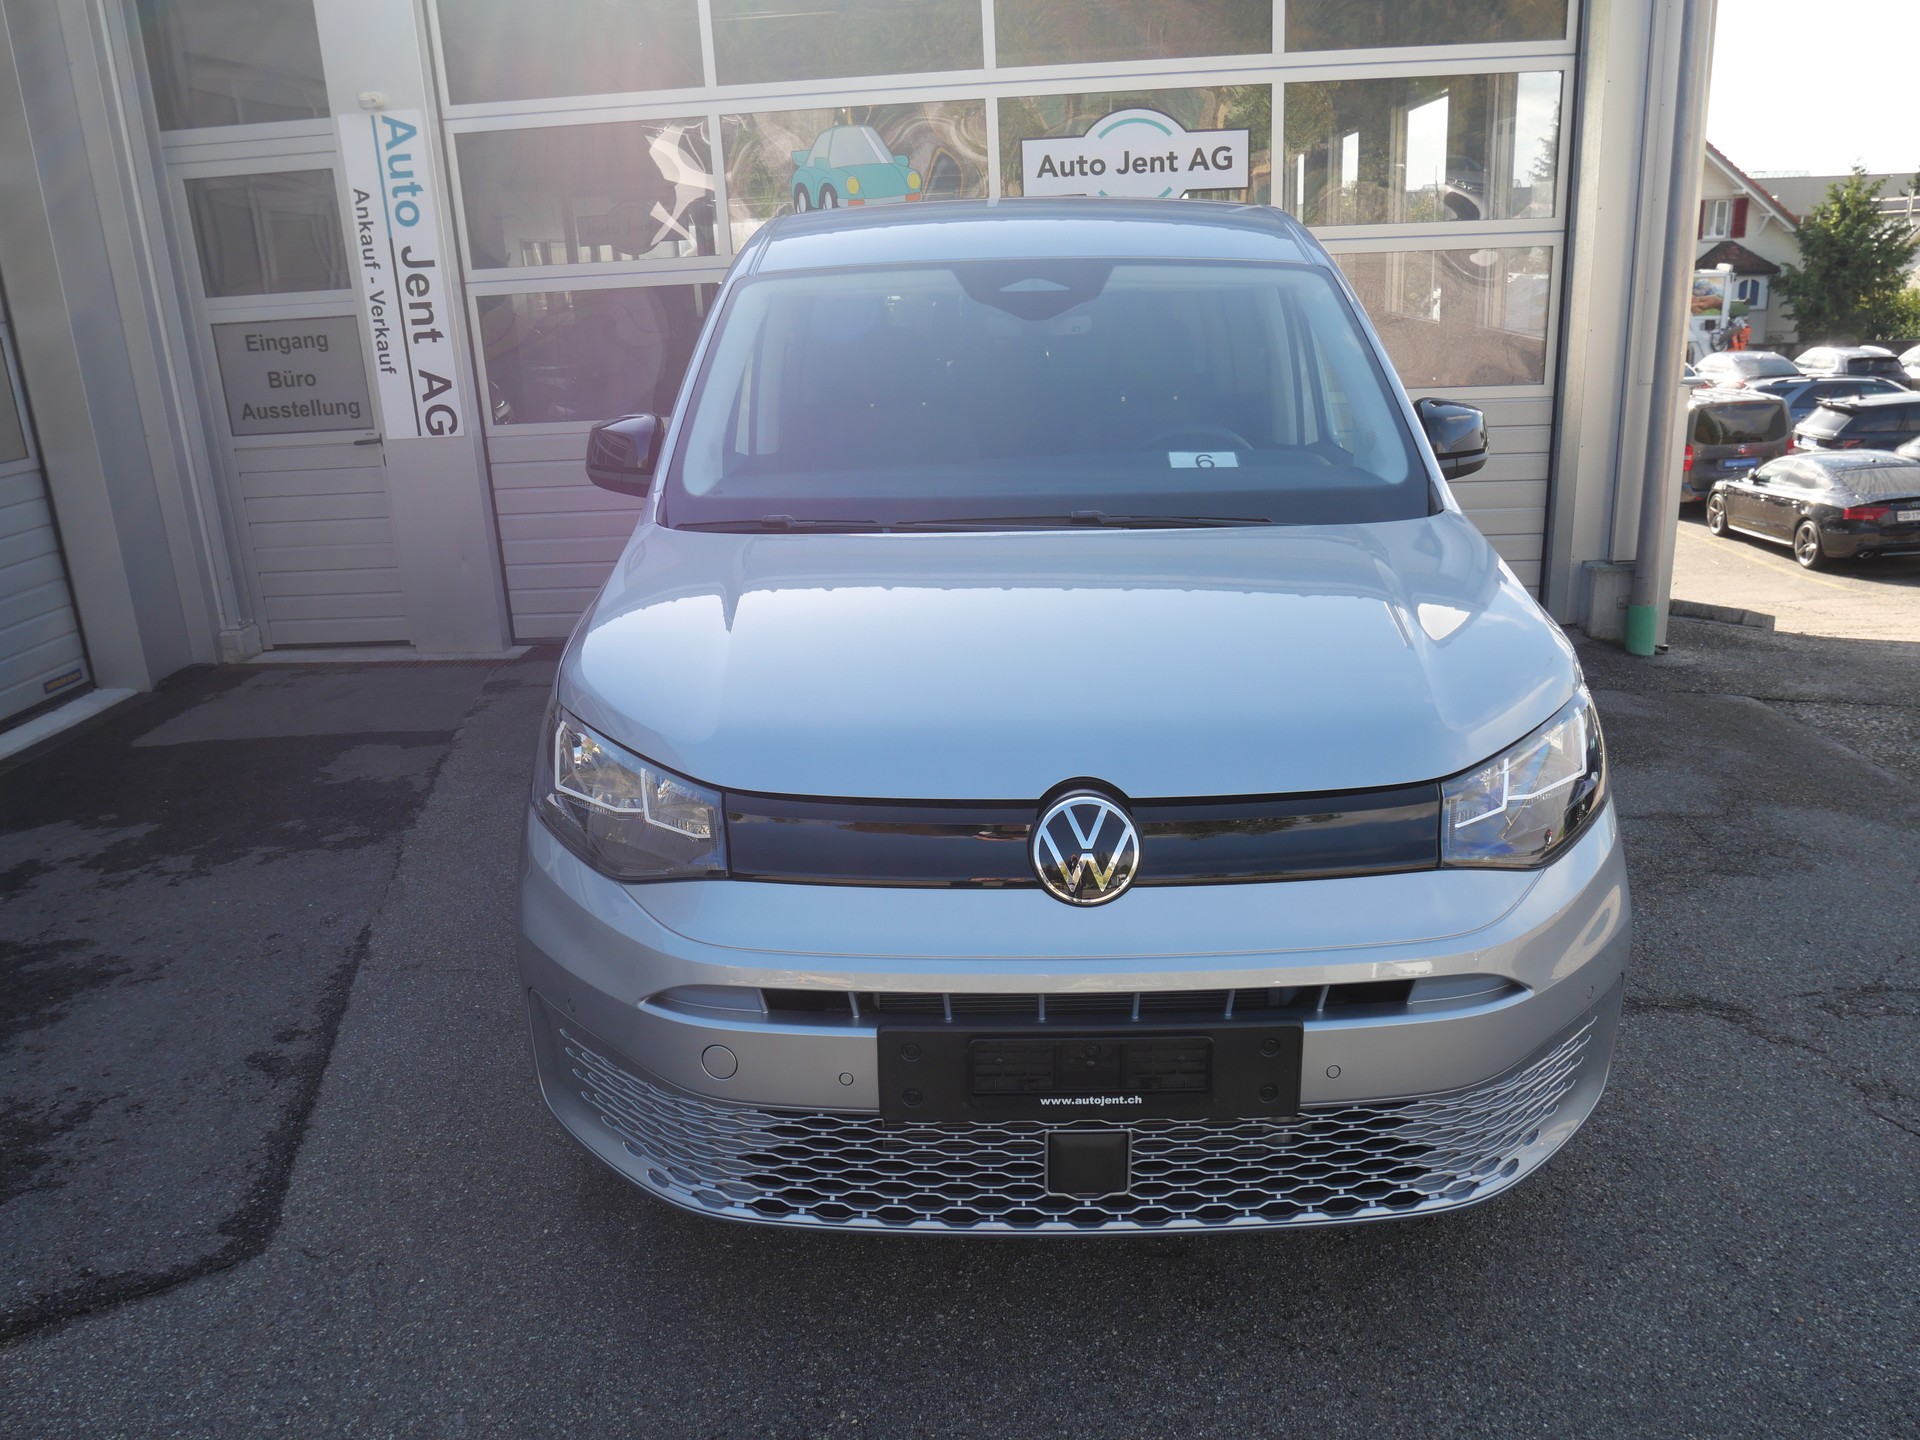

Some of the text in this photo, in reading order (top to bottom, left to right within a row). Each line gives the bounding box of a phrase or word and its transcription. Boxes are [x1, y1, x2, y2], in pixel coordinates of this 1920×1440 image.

[1036, 145, 1233, 179] Auto Jent AG
[353, 187, 381, 270] Ankauf
[369, 289, 397, 375] Verkauf
[381, 114, 458, 436] Auto Jent AG
[244, 333, 329, 355] Eingang
[266, 370, 317, 389] Büro
[241, 399, 361, 421] Ausstellung
[1195, 453, 1216, 468] 6
[1039, 1095, 1143, 1107] www.autojent.ch
